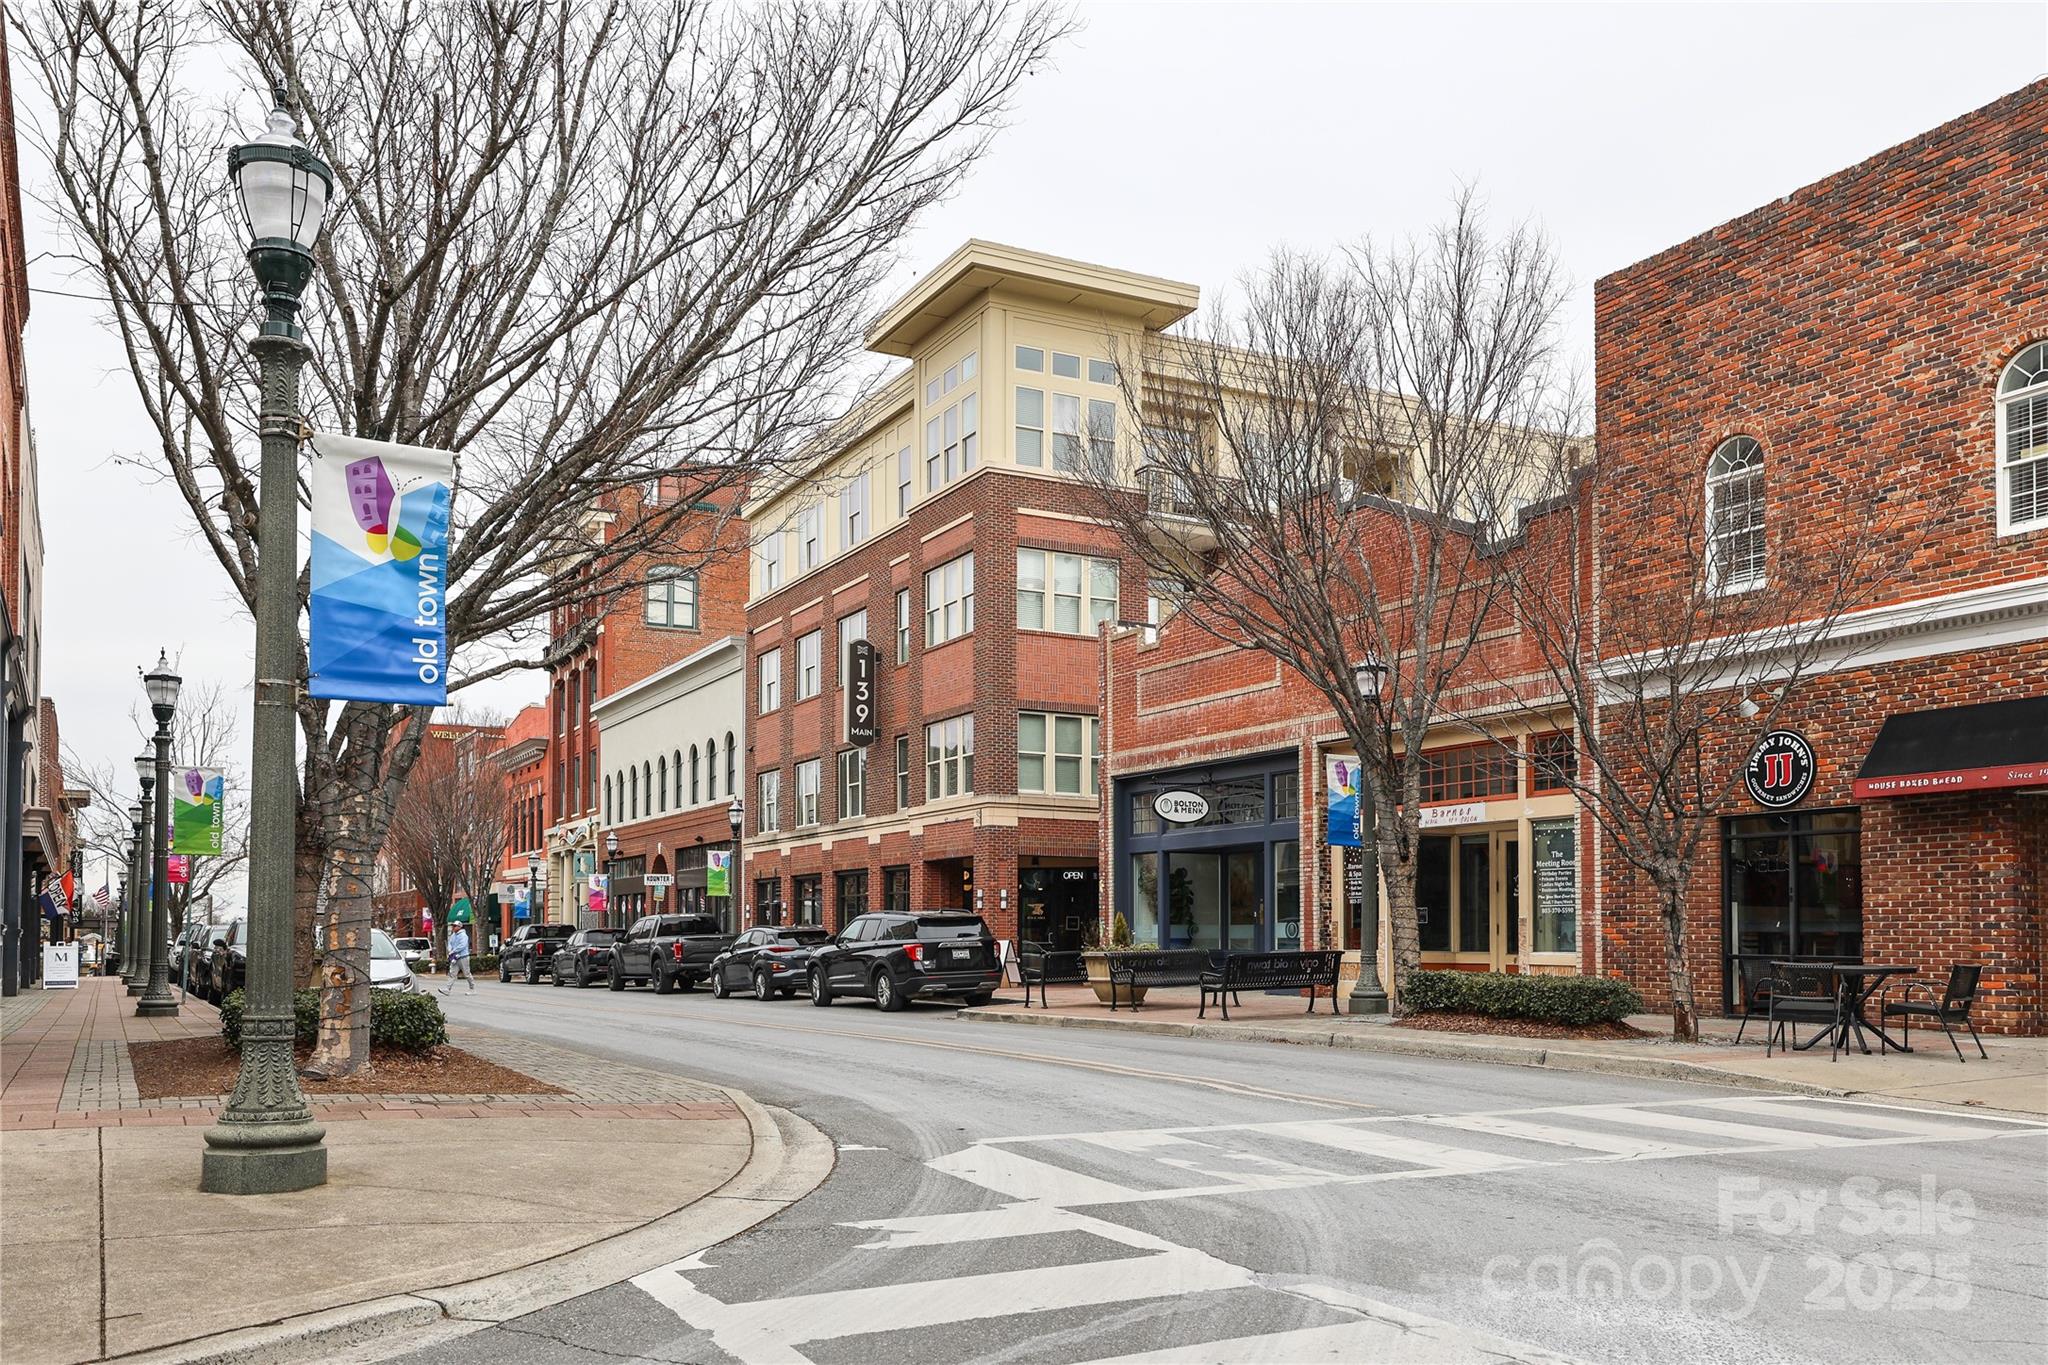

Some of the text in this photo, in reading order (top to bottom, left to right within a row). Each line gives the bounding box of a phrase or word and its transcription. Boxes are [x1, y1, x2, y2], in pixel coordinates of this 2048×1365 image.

[412, 554, 439, 684] old town
[851, 727, 873, 736] MAIN
[1749, 736, 1809, 772] JIMMY JOHN'S
[1764, 752, 1794, 788] JJ
[1868, 780, 1896, 790] HOUSE
[1900, 778, 1929, 788] BAKED
[1932, 775, 1963, 786] BREAD
[2007, 770, 2033, 780] Since
[1751, 772, 1808, 802] GOURMET SANDWICHES
[1173, 800, 1204, 808] BOLTON
[1431, 807, 1472, 818] Barnes
[210, 803, 221, 848] old town
[179, 866, 188, 878] old
[1063, 871, 1084, 880] OPEN
[49, 883, 67, 908] OPEN
[54, 952, 68, 962] M
